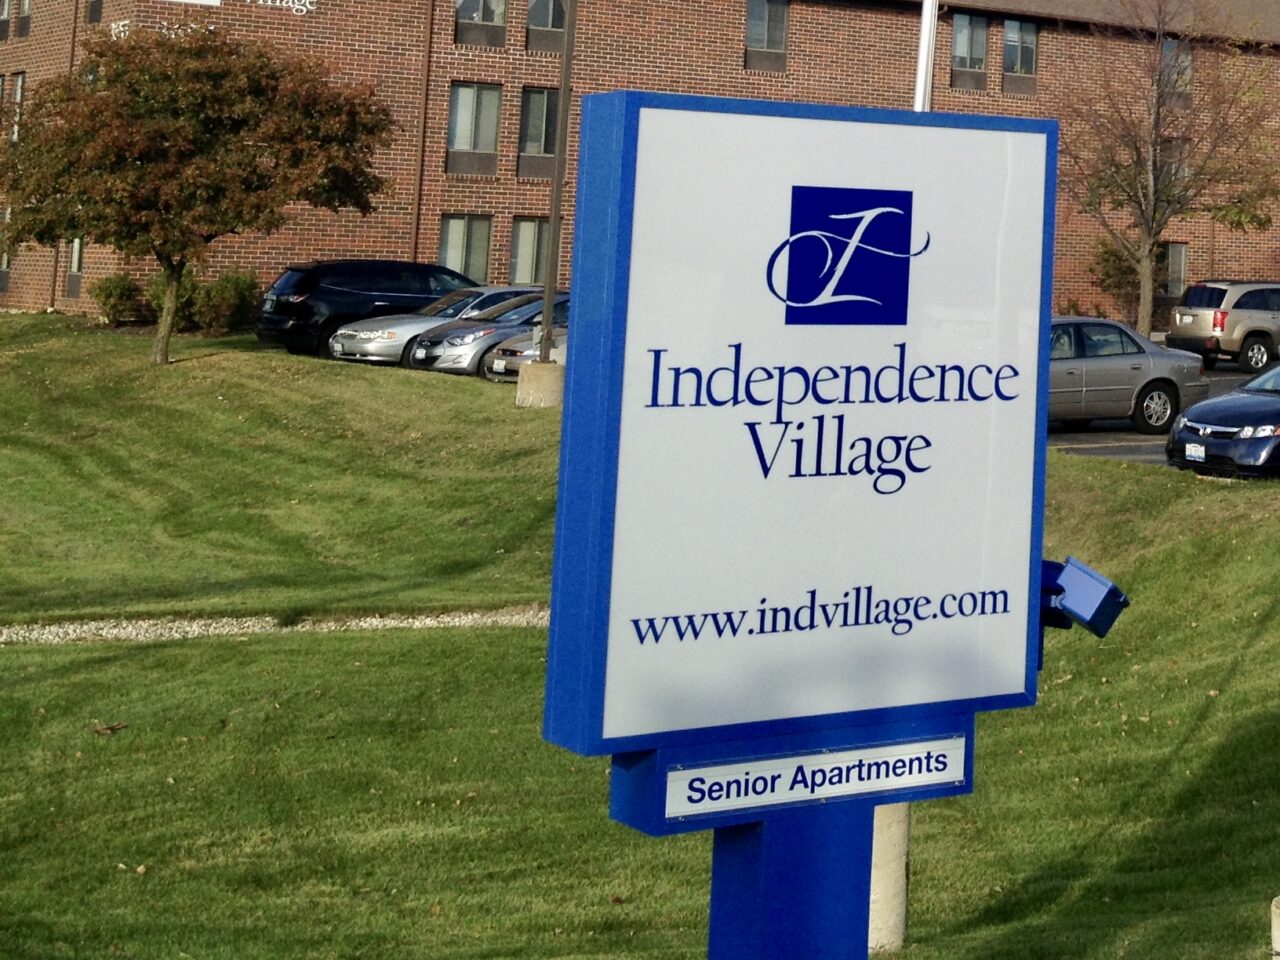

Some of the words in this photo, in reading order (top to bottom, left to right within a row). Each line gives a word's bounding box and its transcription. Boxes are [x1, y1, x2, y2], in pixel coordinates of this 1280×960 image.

[644, 342, 1020, 424] Independence
[744, 414, 933, 495] Village
[630, 585, 1010, 645] www.indvillage.com
[686, 771, 782, 804] Senior
[788, 749, 949, 794] Apartments
